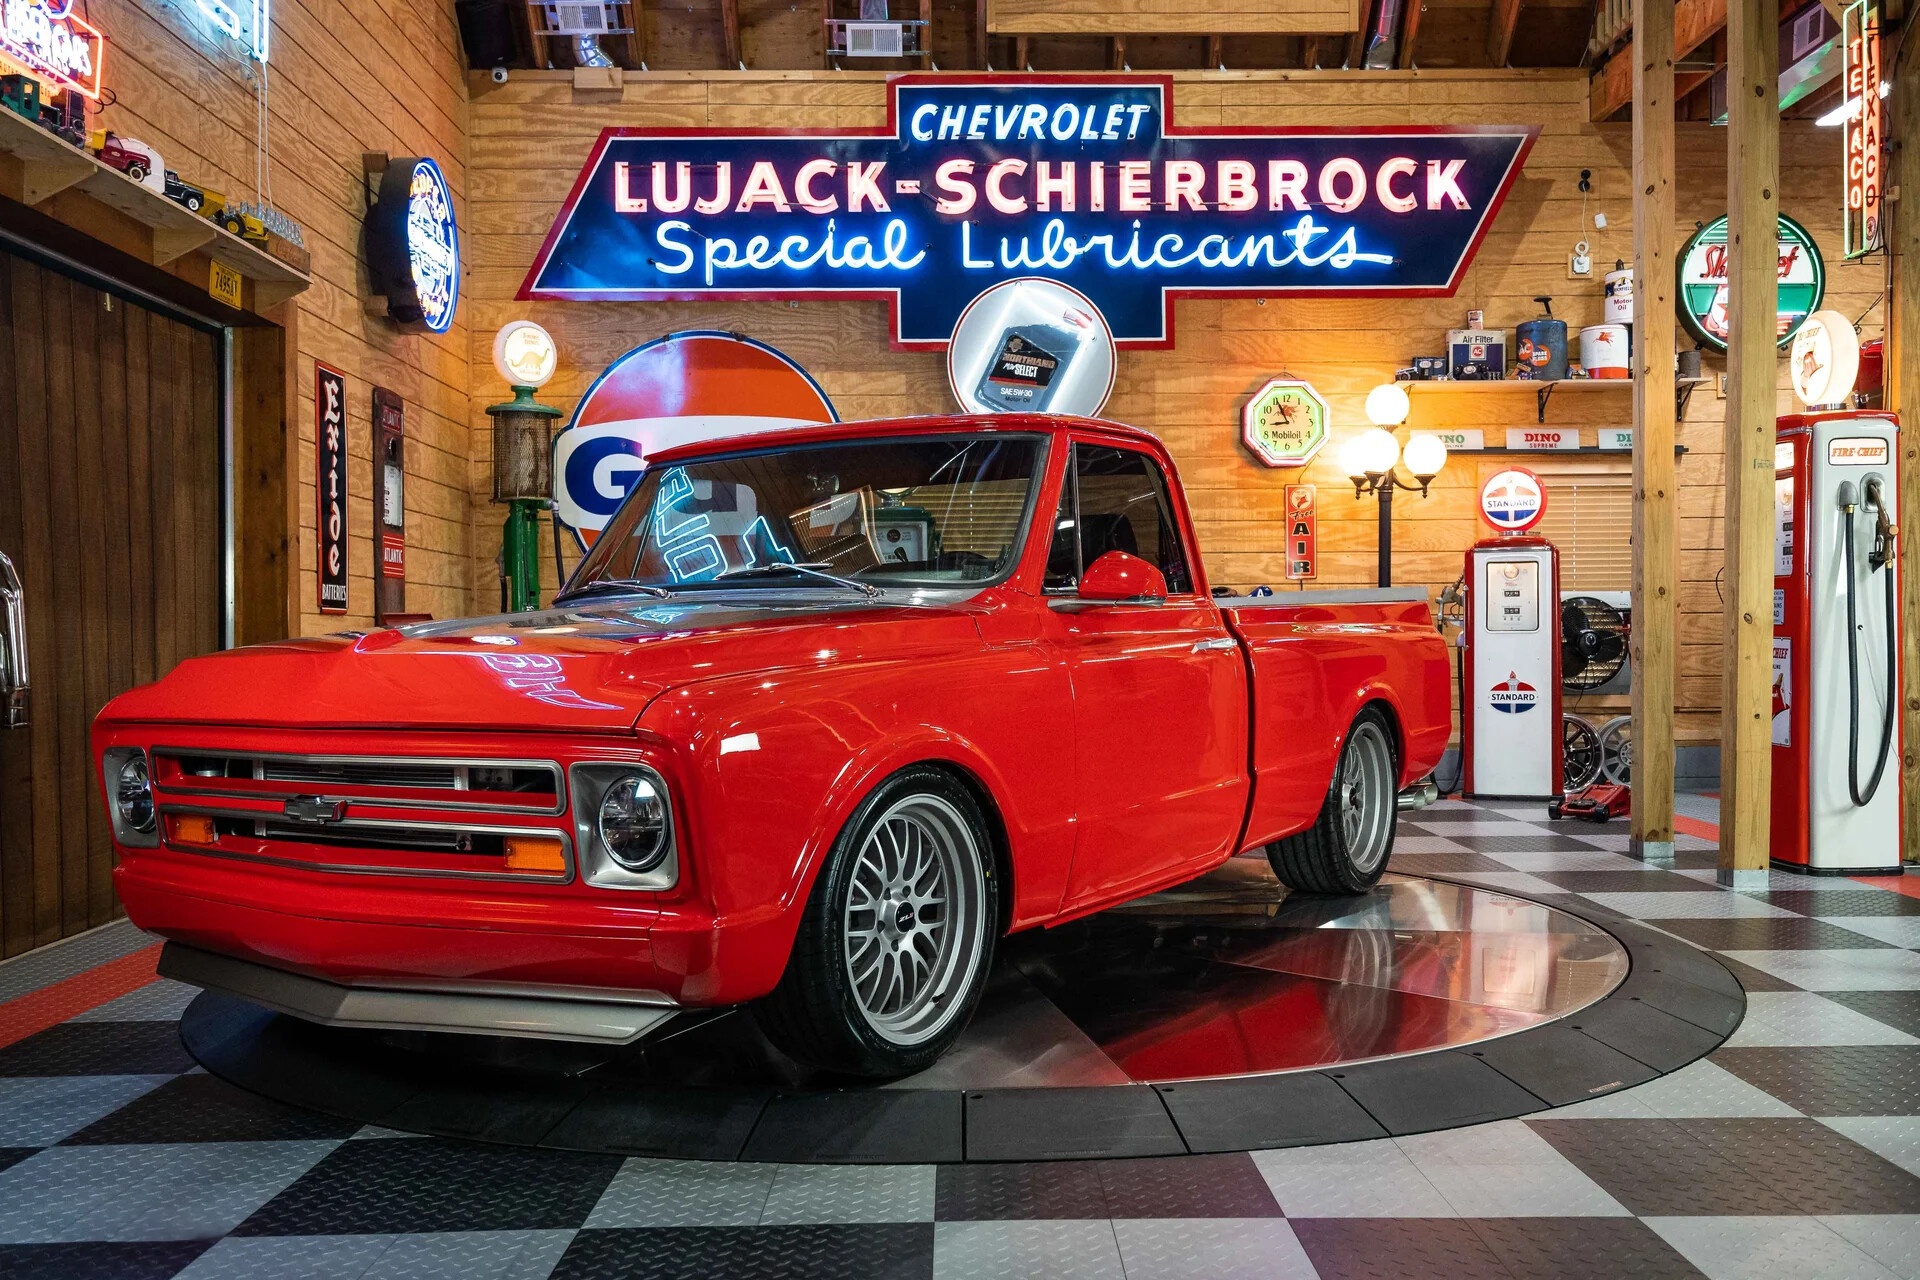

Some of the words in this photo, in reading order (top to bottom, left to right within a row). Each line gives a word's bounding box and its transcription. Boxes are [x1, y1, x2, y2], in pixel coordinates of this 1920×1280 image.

[911, 103, 1151, 141] CHEVROLET
[614, 157, 1472, 214] LUJACK-SCHIERBROCK
[655, 218, 926, 286] Special
[962, 214, 1393, 268] Lubricants
[1462, 335, 1472, 343] Air
[1474, 335, 1494, 343] Filter
[1519, 342, 1531, 355] AC
[1000, 388, 1013, 396] SAE
[1013, 389, 1033, 397] 5W-30
[1271, 430, 1301, 439] Mobiloil
[1524, 433, 1561, 443] DINO
[1616, 433, 1631, 442] DI
[323, 379, 341, 577] Exide
[1487, 498, 1536, 508] STANDARD
[1289, 509, 1314, 521] Free
[1292, 522, 1311, 574] AIR
[384, 547, 403, 564] ATLANTIC
[321, 583, 347, 602] BATTERIES
[1491, 693, 1535, 701] STANDARD
